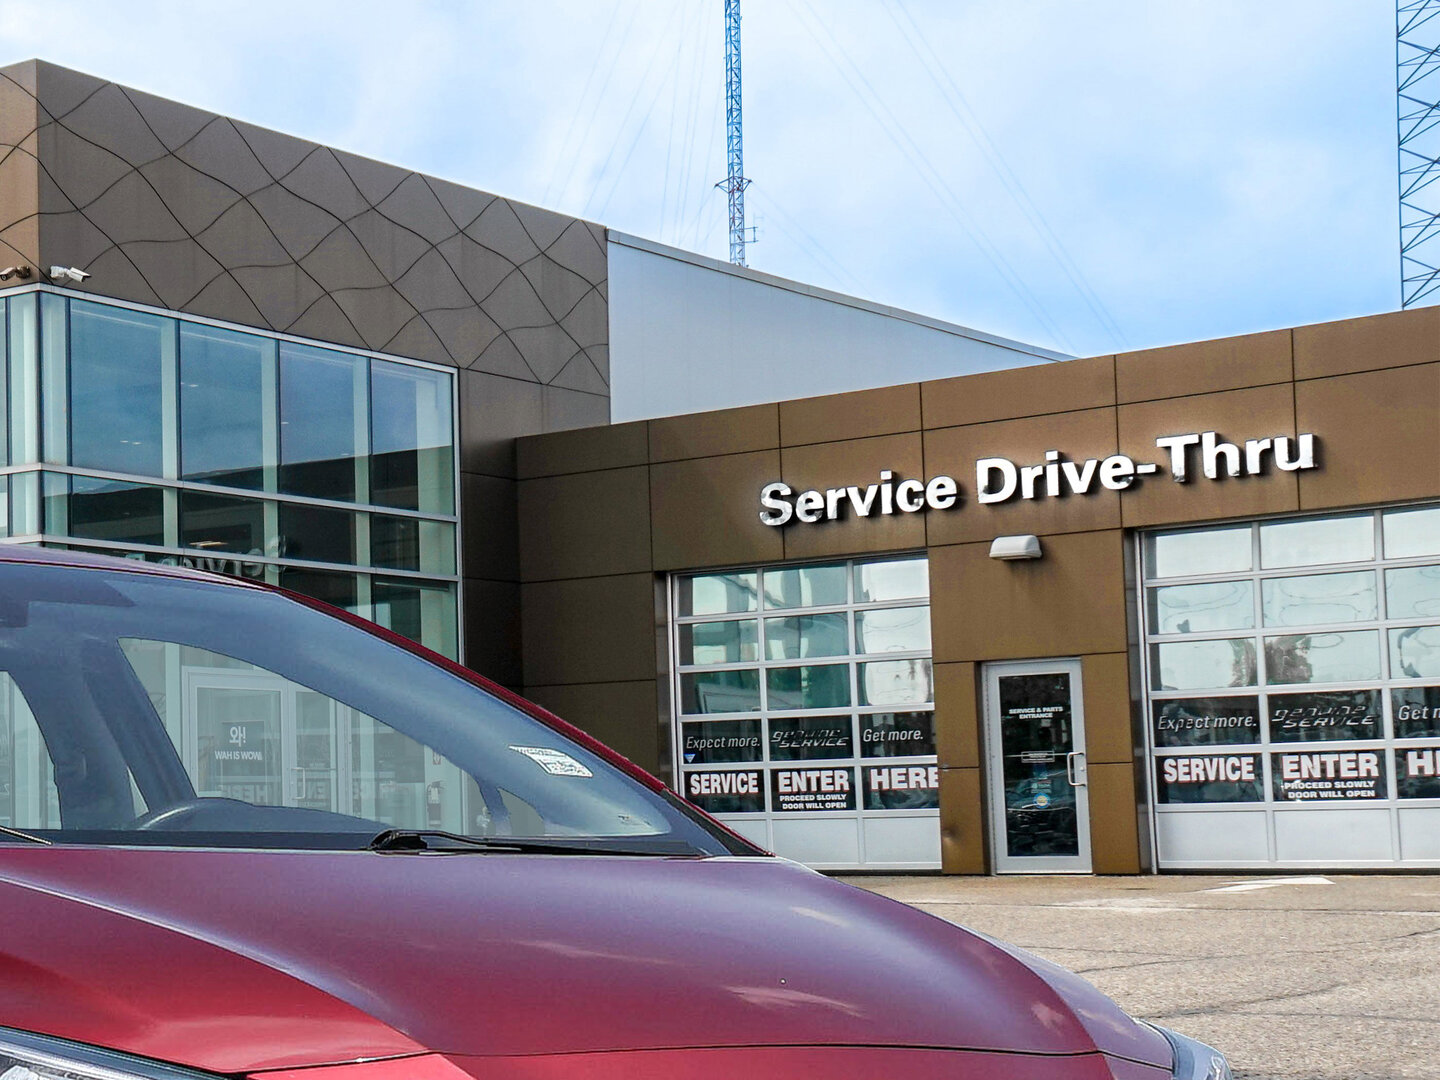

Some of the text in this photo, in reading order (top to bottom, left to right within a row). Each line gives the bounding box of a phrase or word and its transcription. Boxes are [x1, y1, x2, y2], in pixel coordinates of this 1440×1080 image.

[759, 431, 1317, 527] Service Drive-Thru
[1398, 705, 1428, 721] Get
[1158, 714, 1257, 732] Expect more.
[1283, 716, 1375, 728] SERVICE
[229, 726, 246, 747] 와!
[686, 735, 760, 750] Expect more.
[779, 737, 850, 748] SERVICE
[863, 729, 924, 742] Get more.
[215, 751, 233, 760] WAH
[233, 751, 240, 760] IS
[1164, 757, 1254, 782] SERVICE
[1282, 753, 1379, 779] ENTER
[691, 773, 759, 794] SERVICE
[778, 770, 850, 793] ENTER
[1334, 780, 1375, 788] SLOWLY
[1288, 789, 1375, 799] DOOR WILL OPEN
